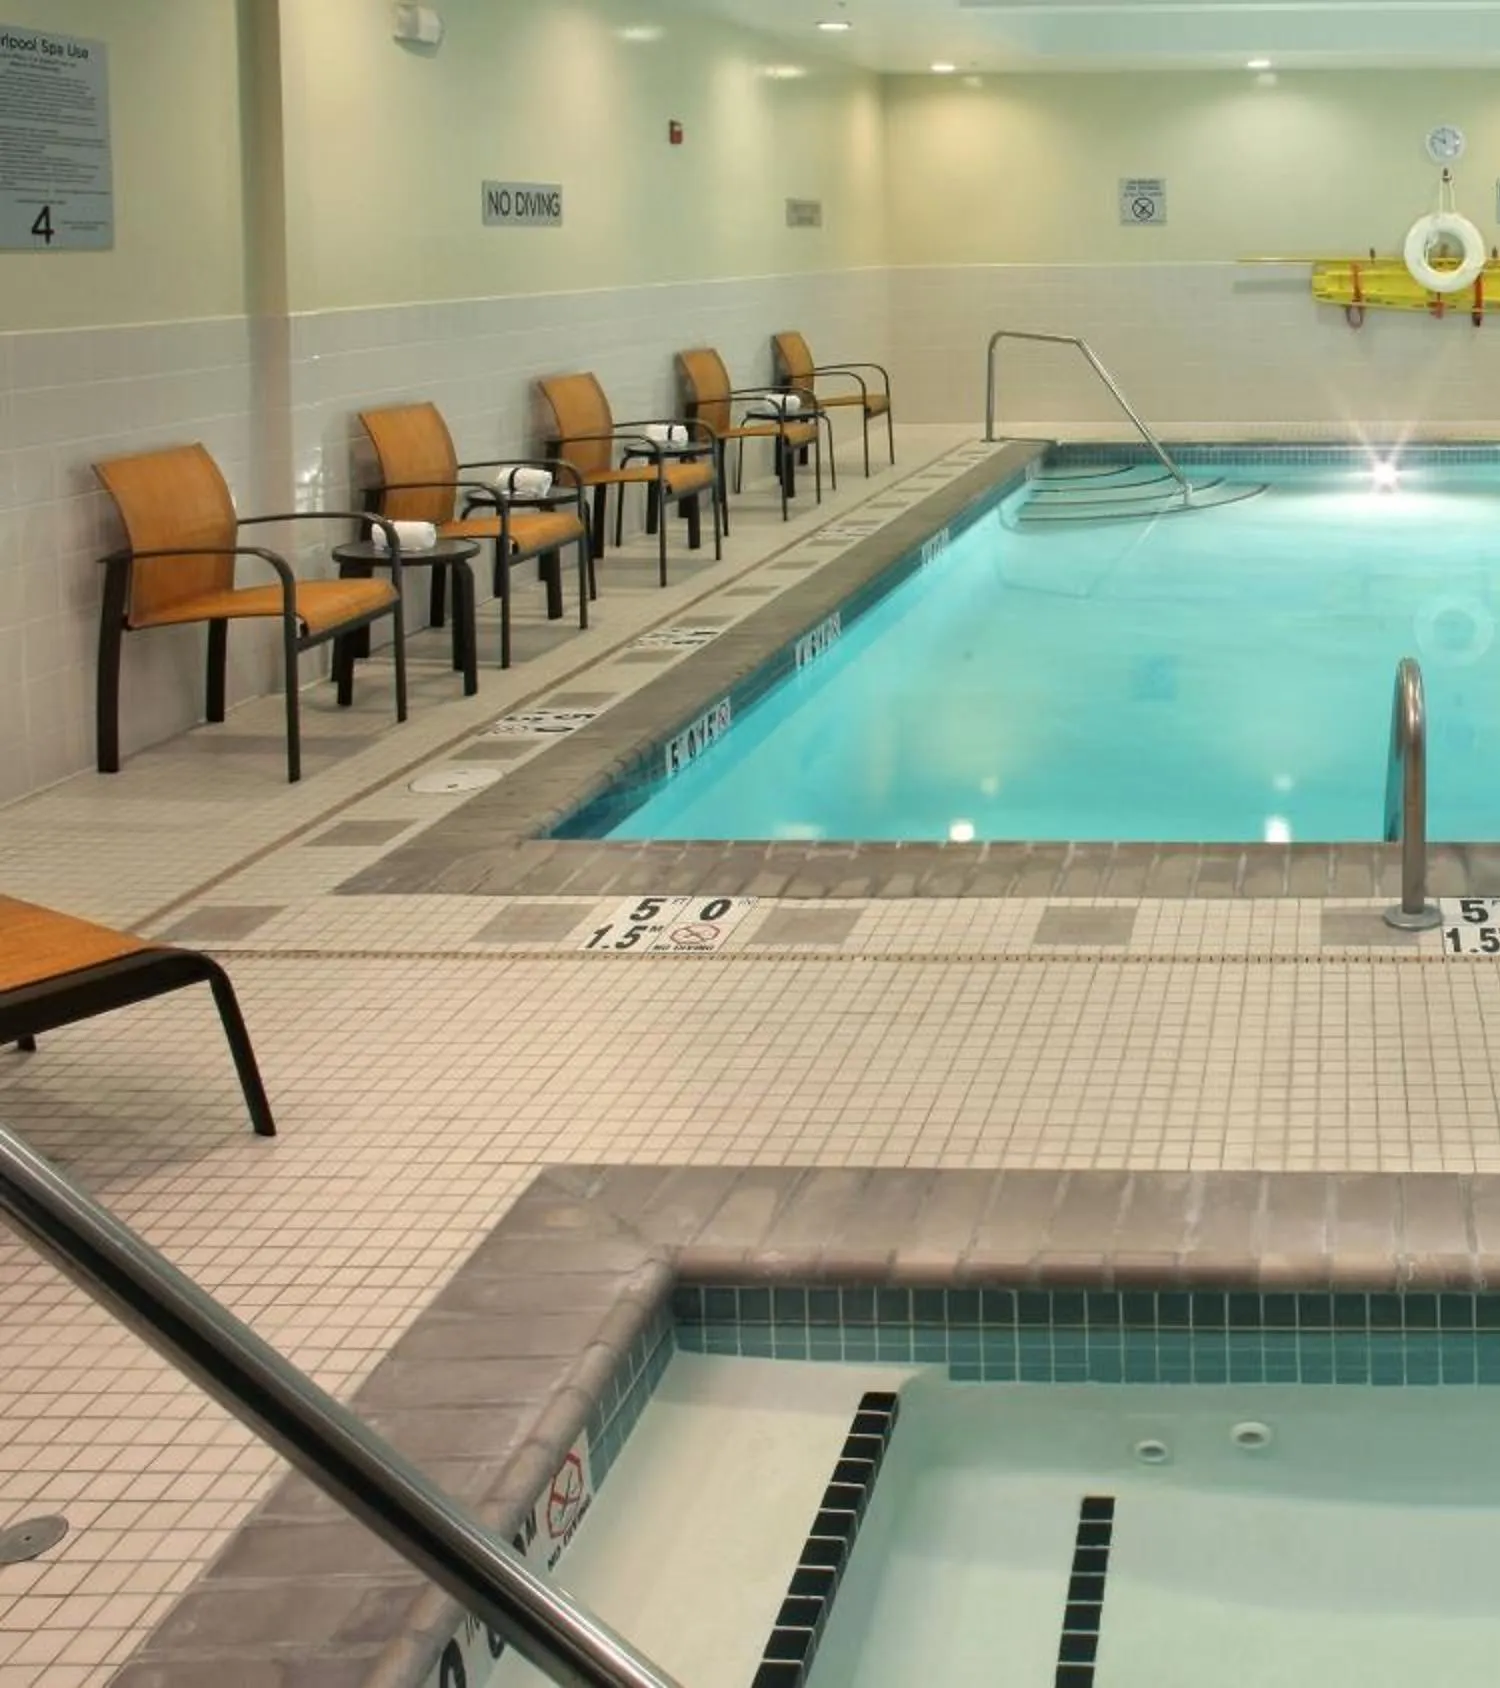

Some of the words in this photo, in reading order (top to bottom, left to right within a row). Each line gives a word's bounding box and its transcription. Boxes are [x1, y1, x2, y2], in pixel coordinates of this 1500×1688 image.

[41, 38, 64, 57] Spa
[67, 42, 89, 59] Use
[488, 190, 511, 217] NO
[515, 191, 561, 217] DIVING
[31, 205, 55, 244] 4
[629, 898, 667, 920] 5
[700, 899, 732, 920] 0
[1460, 899, 1489, 923] 5
[586, 923, 649, 949] 1.5
[1446, 927, 1500, 953] 1.5
